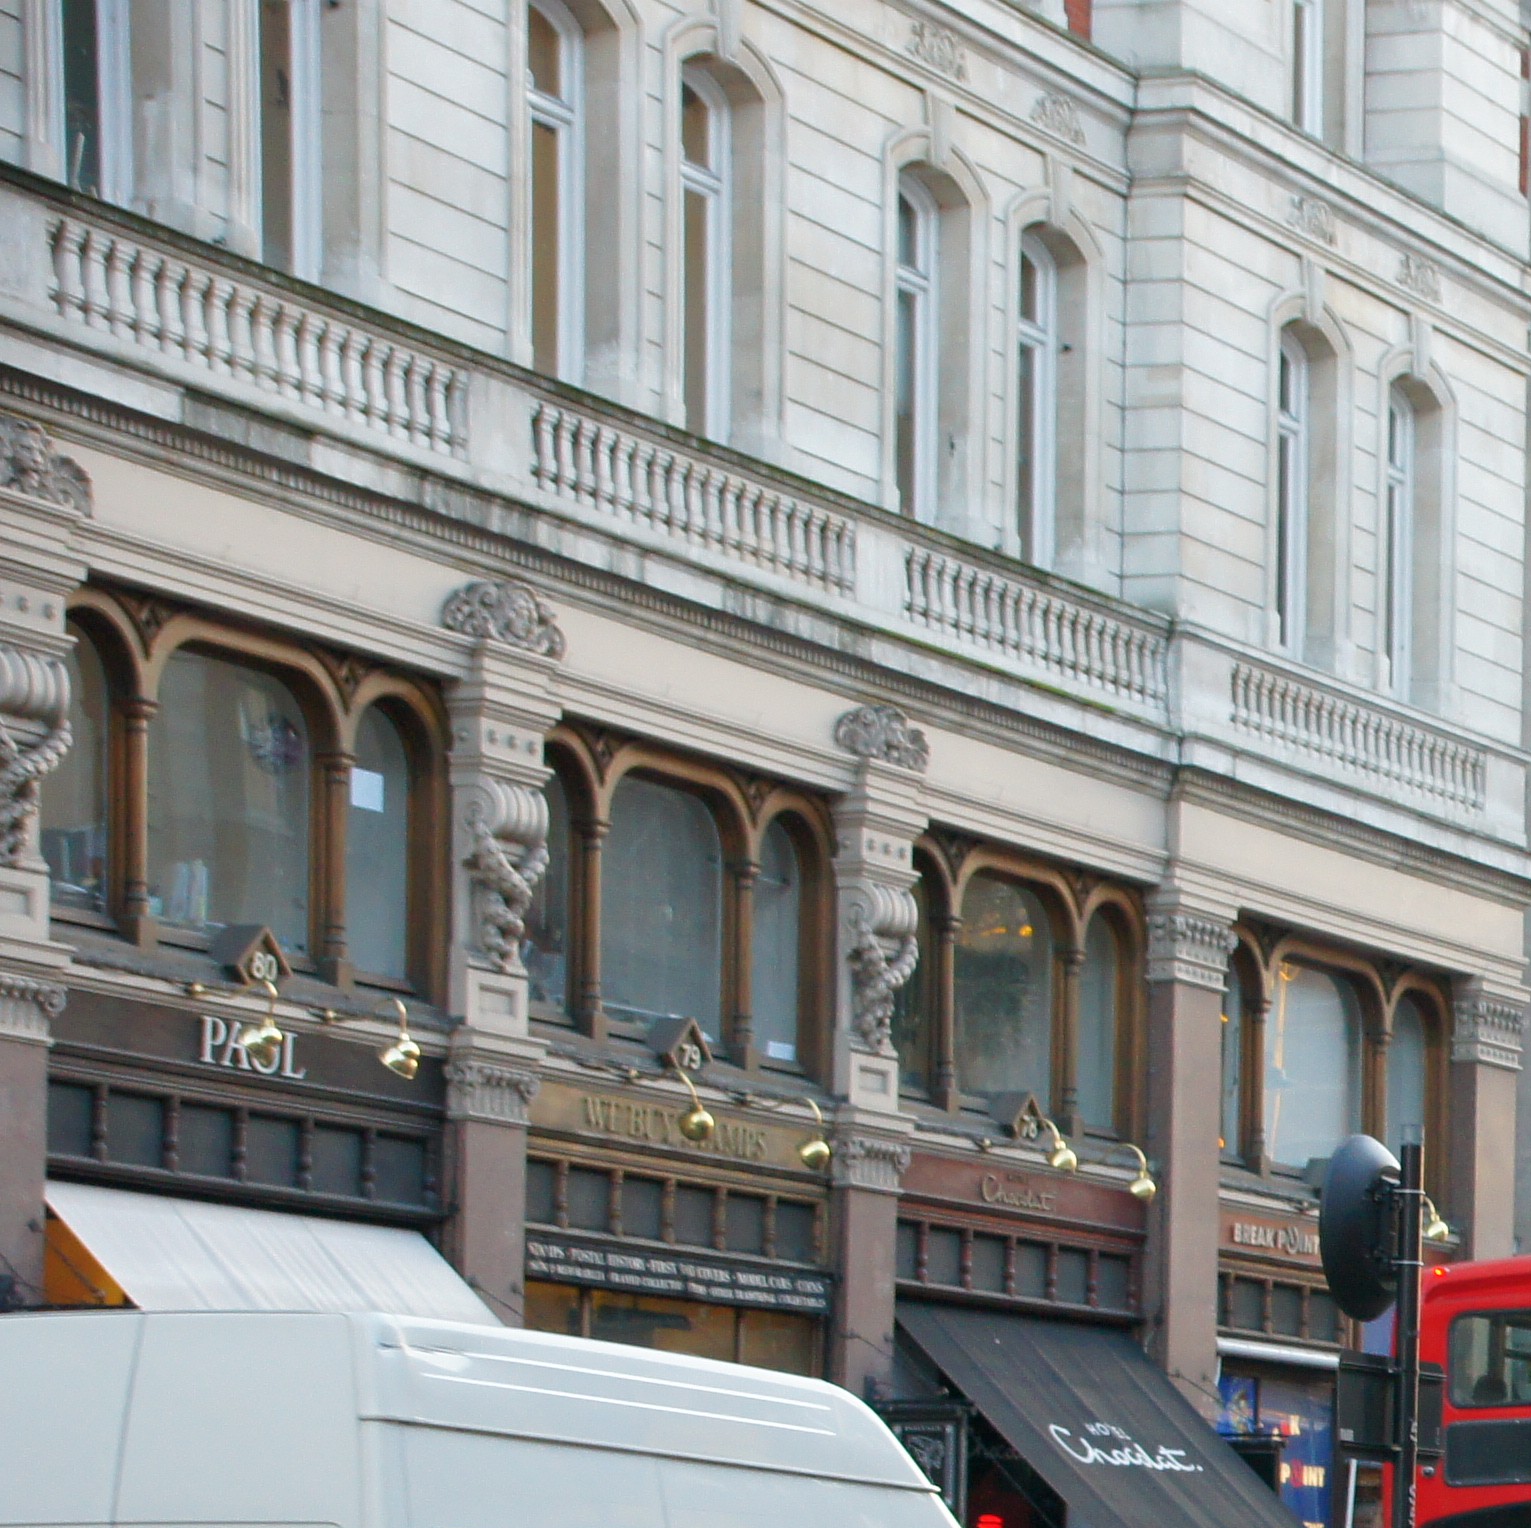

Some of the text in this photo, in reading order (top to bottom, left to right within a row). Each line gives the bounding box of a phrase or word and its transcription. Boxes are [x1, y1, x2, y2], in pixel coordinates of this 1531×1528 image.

[200, 1015, 306, 1080] PAUL
[679, 1043, 701, 1070] 79
[584, 1096, 620, 1132] WE
[1233, 1222, 1320, 1255] BREAK POINT
[1084, 1422, 1131, 1440] HOTEL
